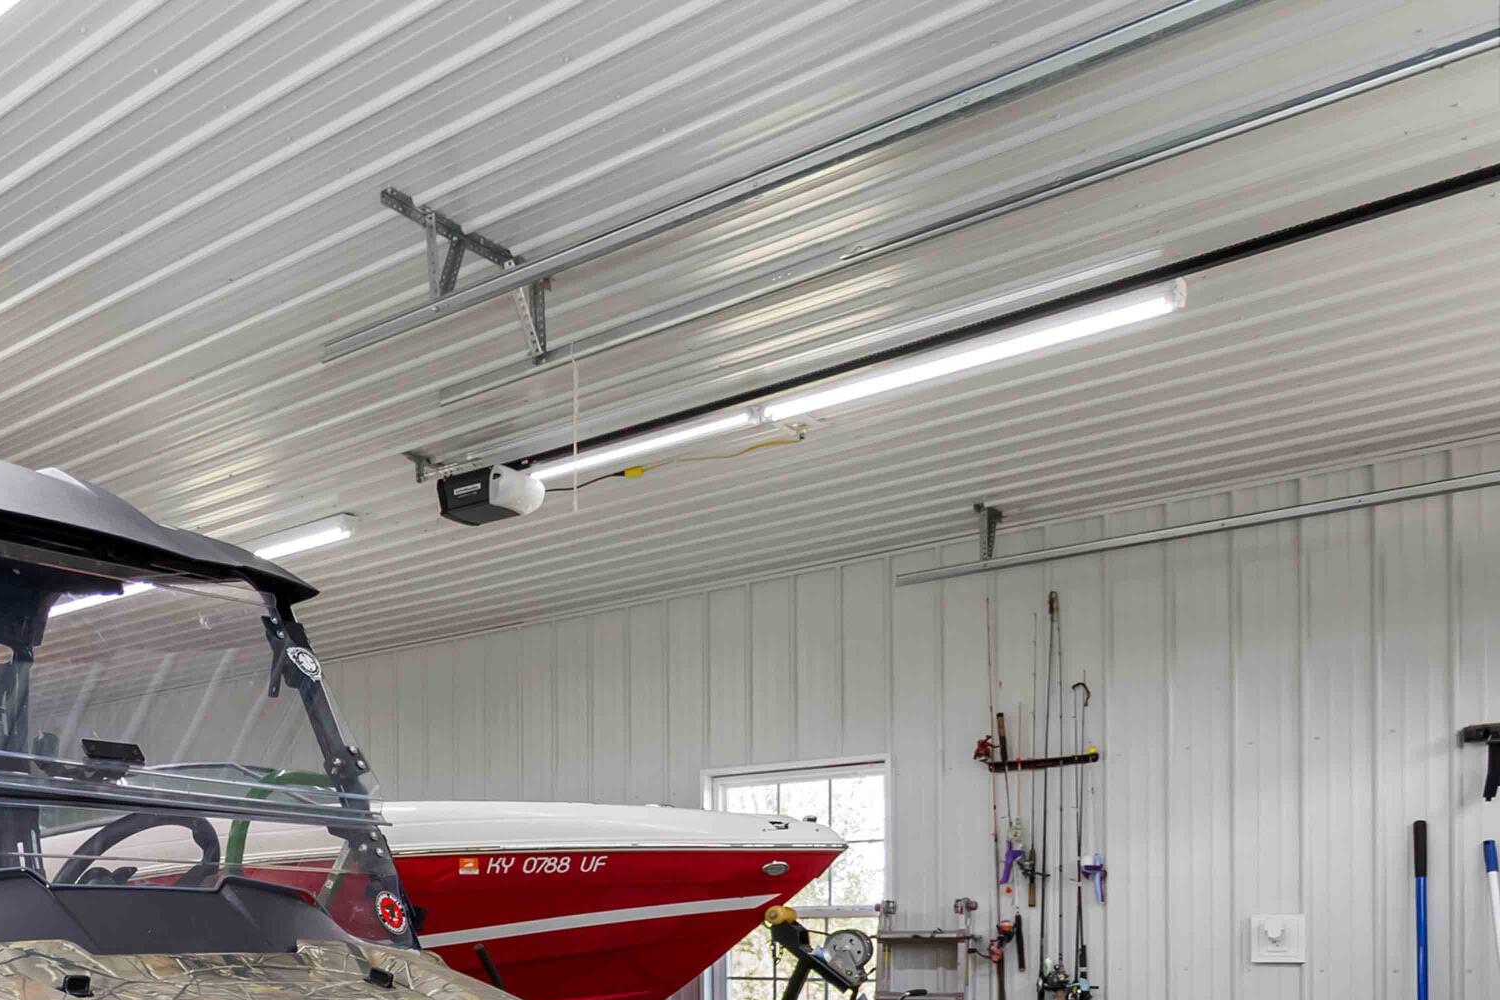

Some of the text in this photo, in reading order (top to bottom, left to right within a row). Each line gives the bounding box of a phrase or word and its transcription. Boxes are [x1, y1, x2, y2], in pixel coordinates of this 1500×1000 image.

[486, 857, 515, 875] KY
[522, 856, 571, 874] 0788
[580, 855, 608, 873] UF
